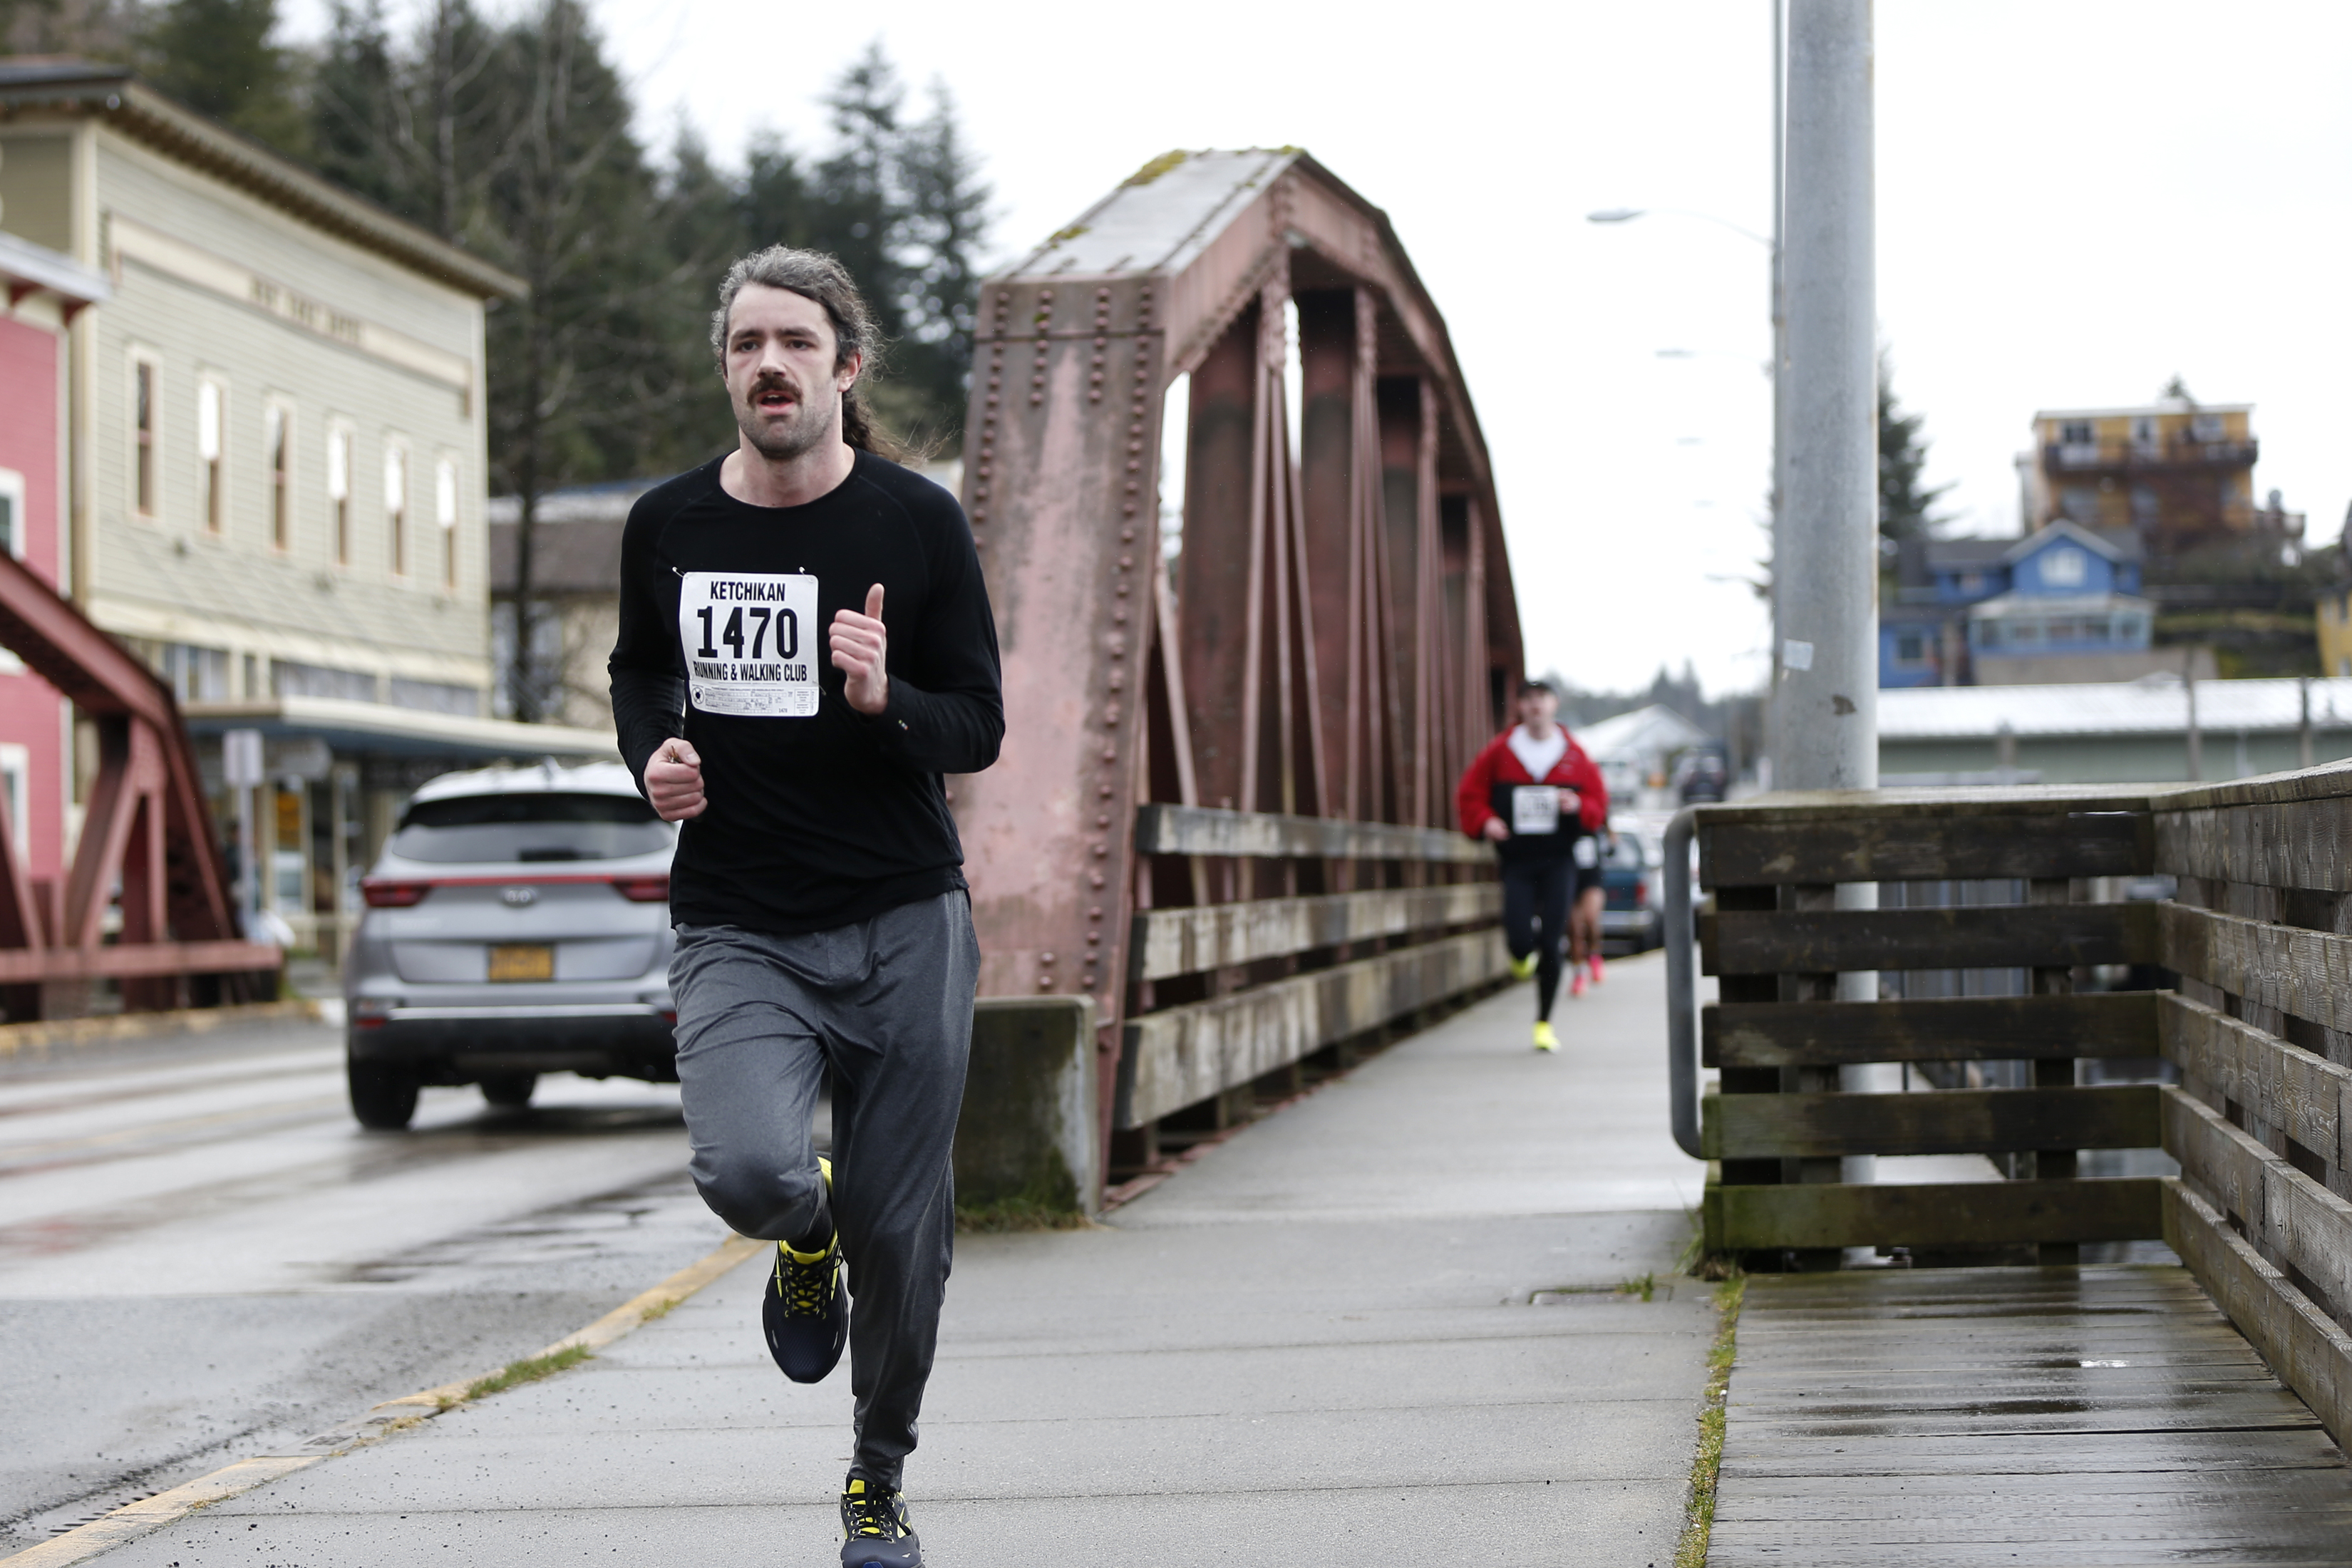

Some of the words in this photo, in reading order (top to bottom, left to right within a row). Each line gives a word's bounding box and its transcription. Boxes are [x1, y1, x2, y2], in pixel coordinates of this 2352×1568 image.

[710, 581, 785, 602] KETCHIKAN
[697, 606, 798, 659] 1470
[693, 661, 728, 681] RUNNING
[731, 663, 738, 681] &
[740, 664, 781, 681] WALKING
[784, 664, 807, 681] CLUB
